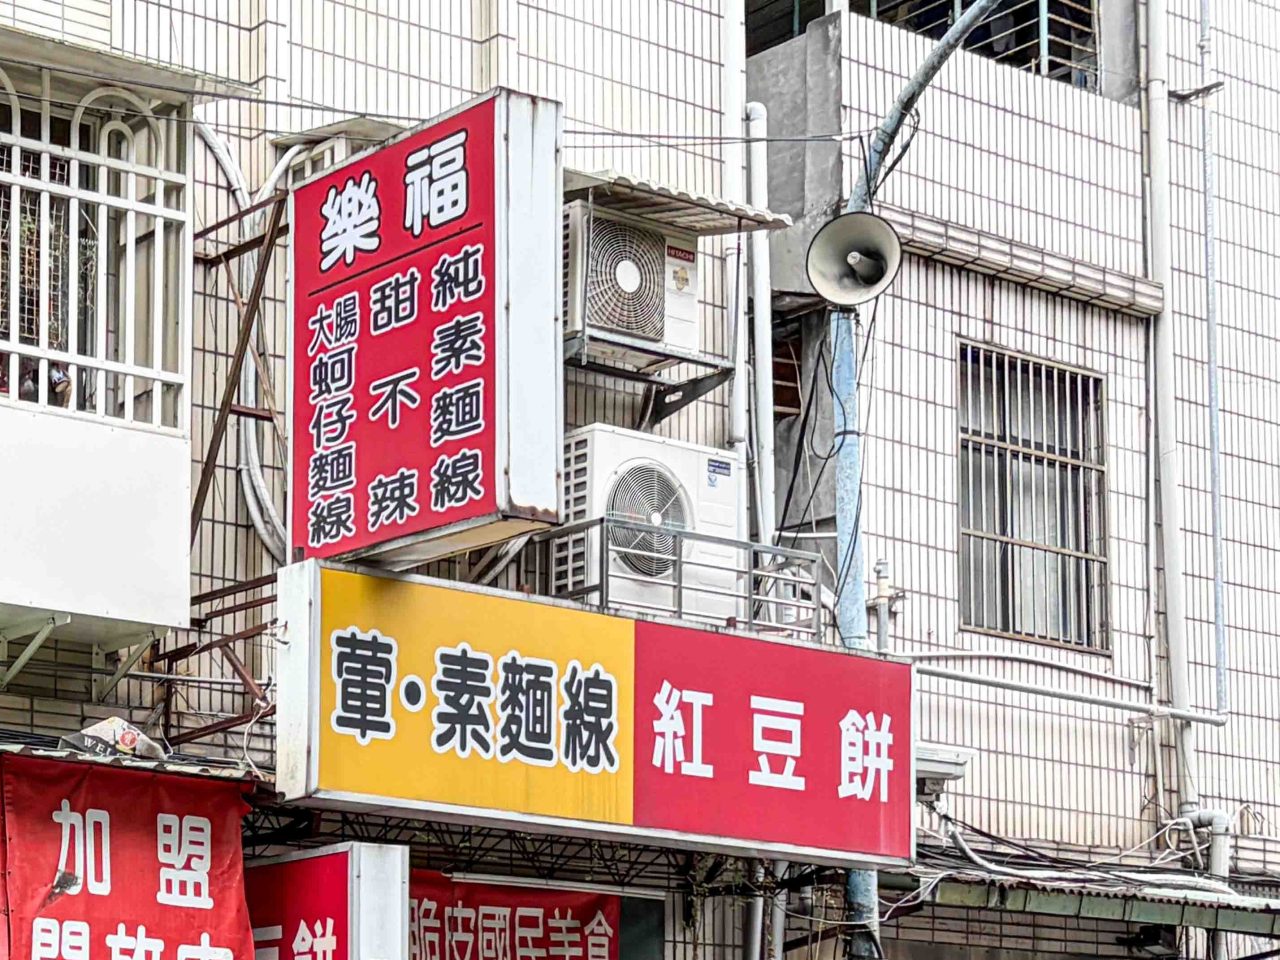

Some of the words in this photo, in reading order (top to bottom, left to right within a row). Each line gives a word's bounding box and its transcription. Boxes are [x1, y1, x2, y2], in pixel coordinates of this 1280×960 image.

[319, 129, 469, 272] 樂福
[668, 248, 694, 261] HITACHI
[307, 291, 359, 549] 大腸蚵仔麵線
[367, 269, 419, 531] 甜不辣
[431, 243, 485, 514] 純素麵線
[651, 680, 894, 803] 紅豆餅
[52, 799, 214, 909] 加盟
